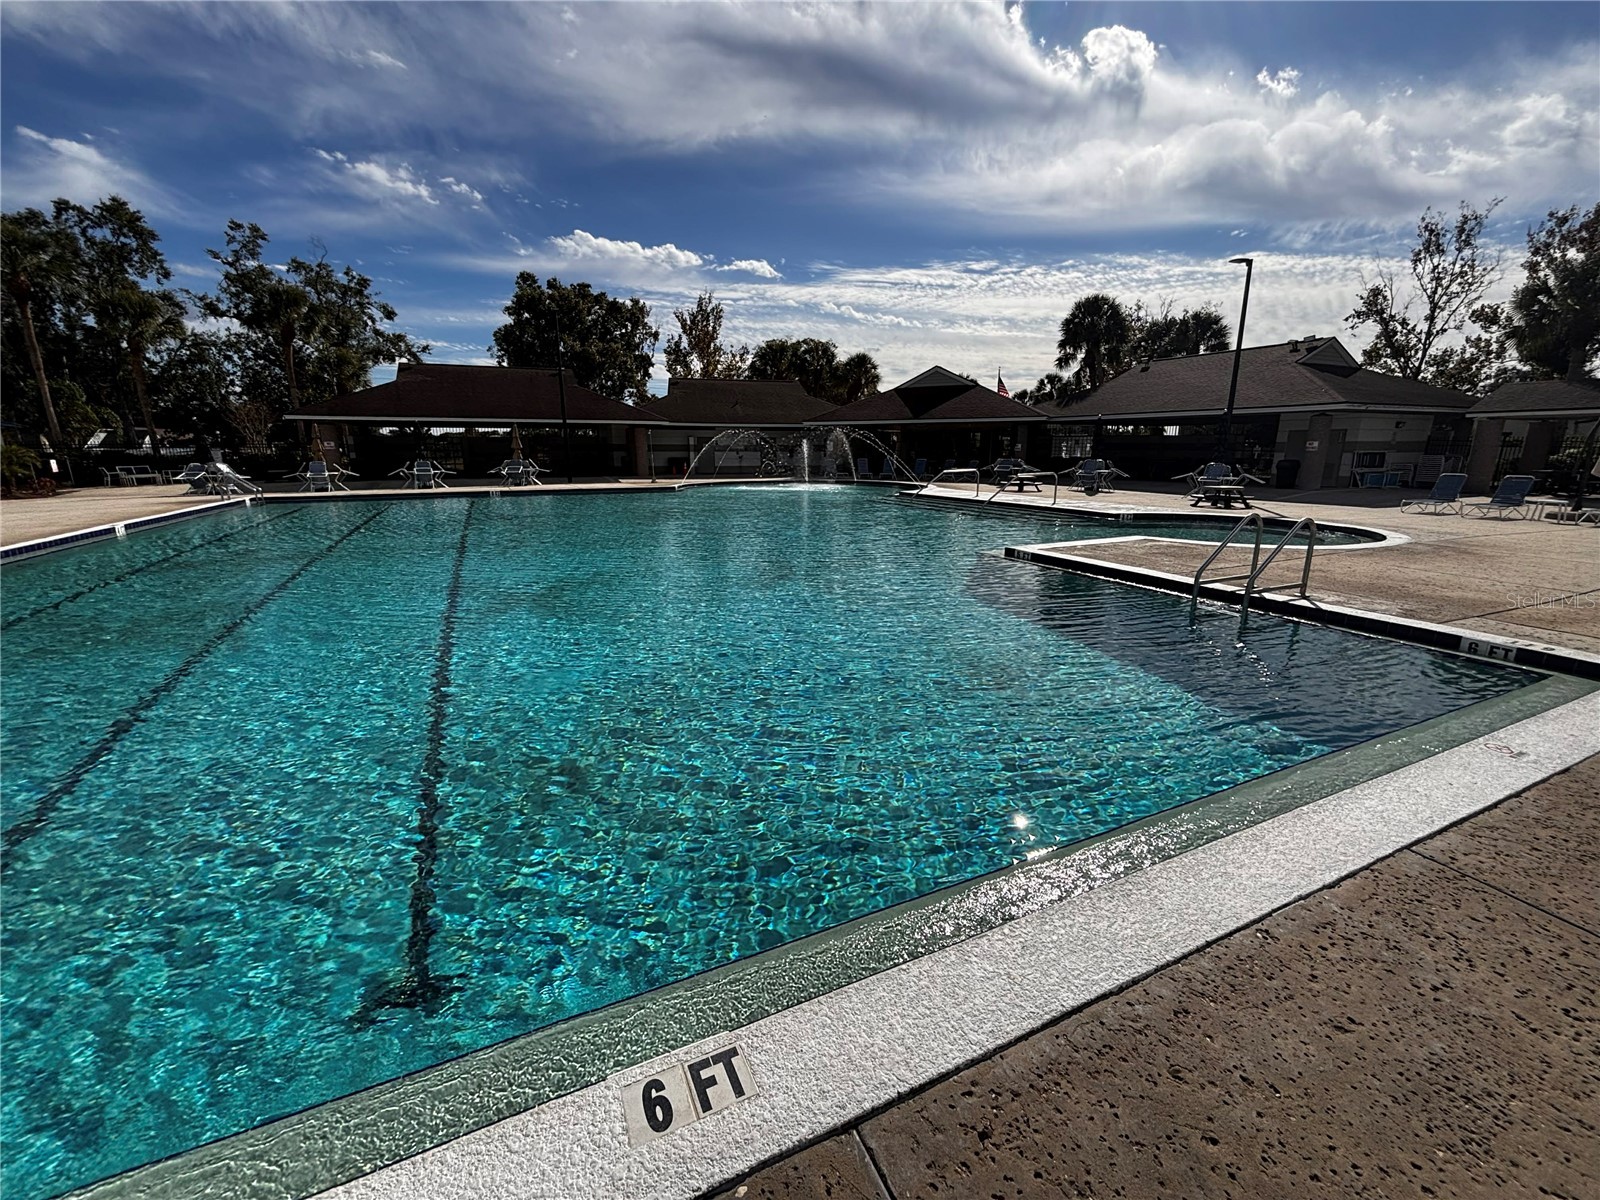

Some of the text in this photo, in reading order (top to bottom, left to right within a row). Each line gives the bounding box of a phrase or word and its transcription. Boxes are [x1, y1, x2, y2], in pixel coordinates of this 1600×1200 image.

[1467, 641, 1479, 654] 6
[1487, 643, 1514, 659] FT
[642, 1046, 746, 1133] 6 FT
